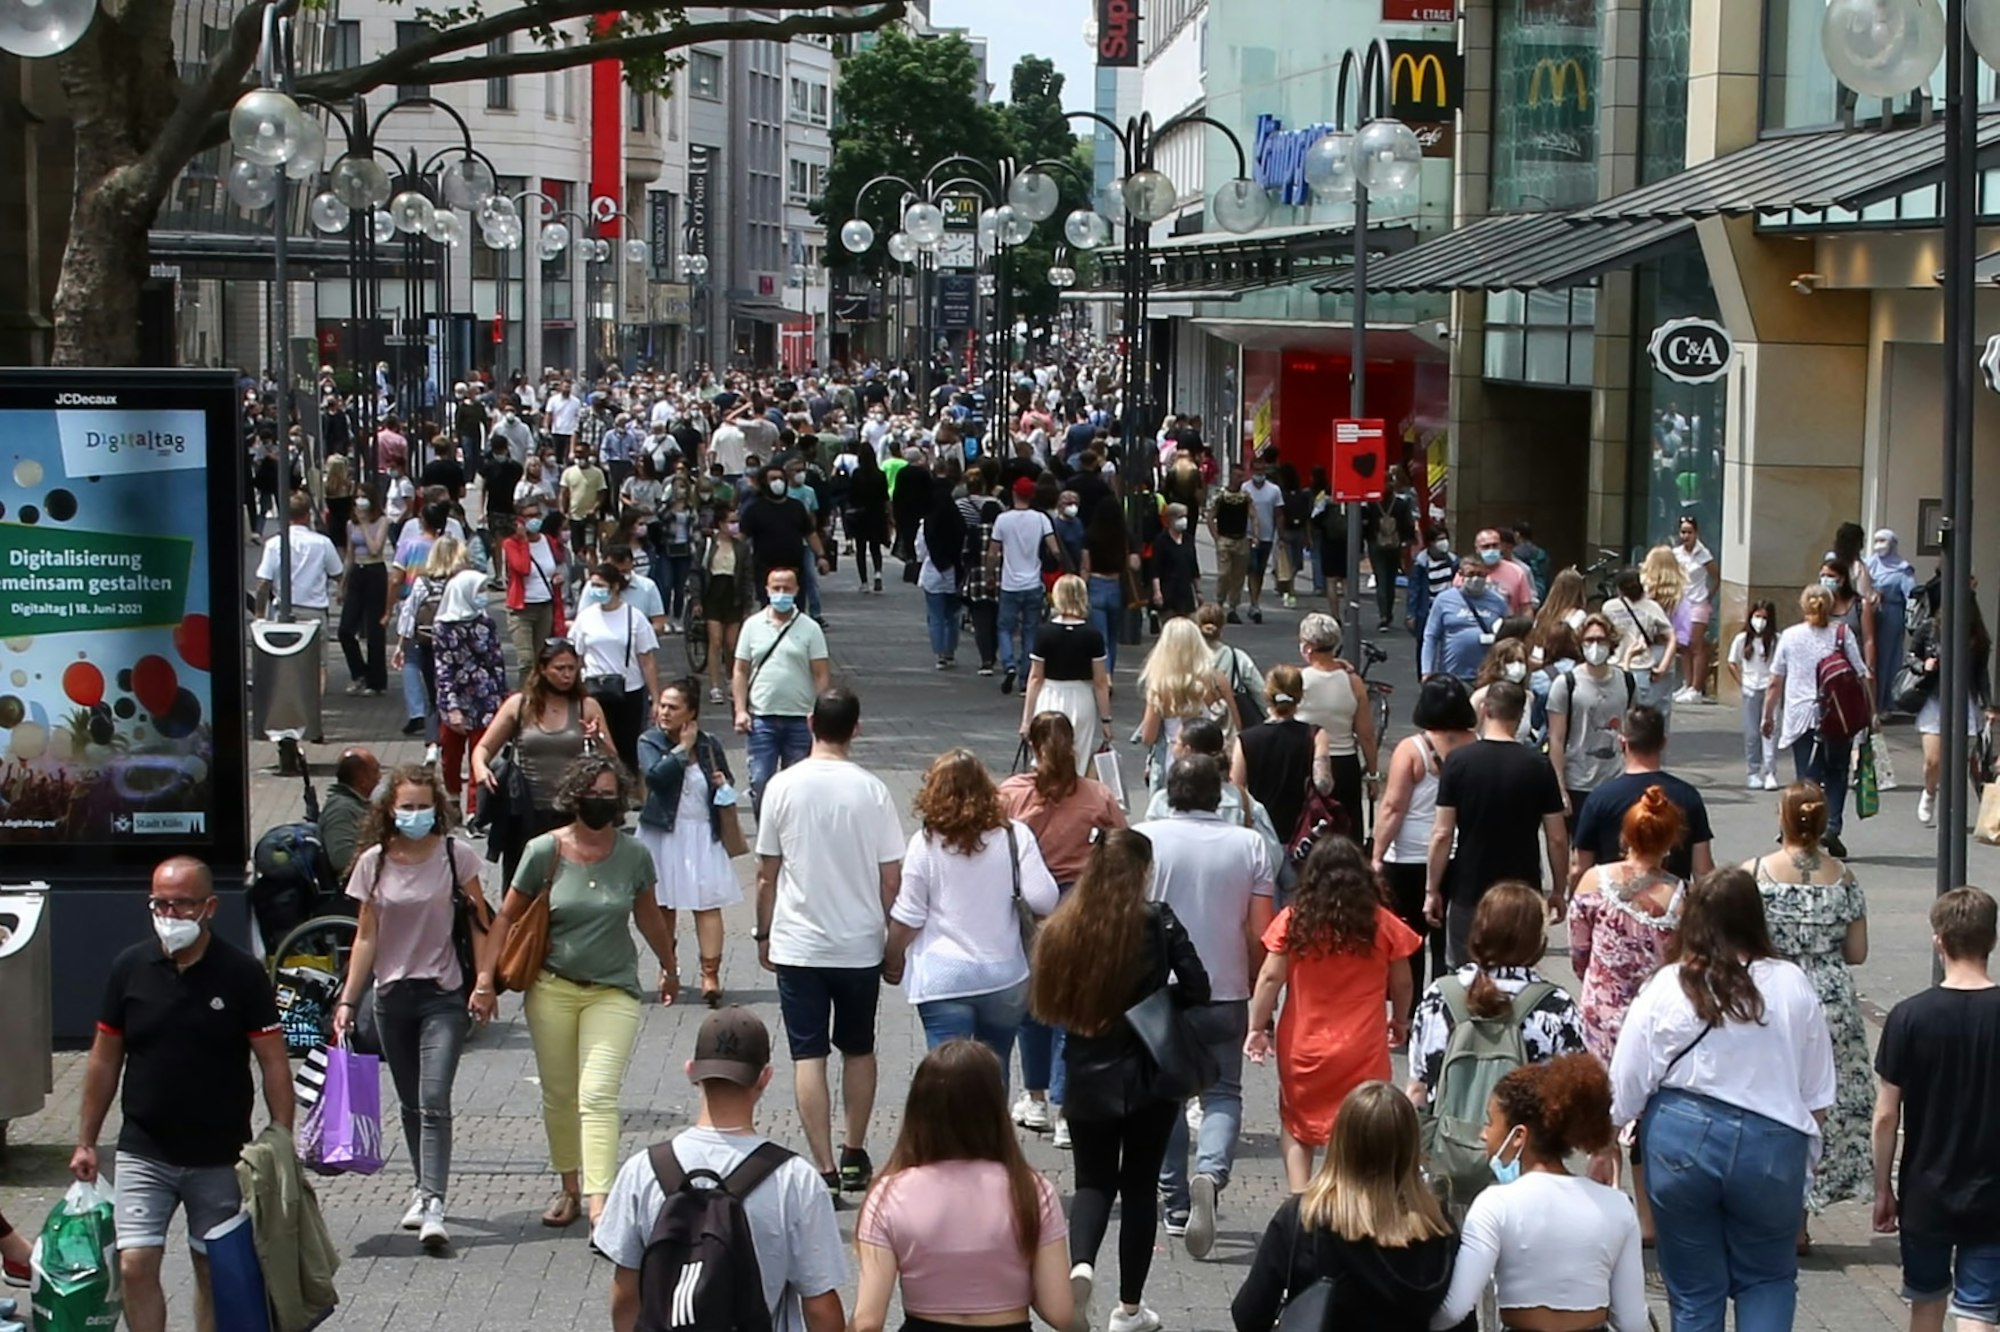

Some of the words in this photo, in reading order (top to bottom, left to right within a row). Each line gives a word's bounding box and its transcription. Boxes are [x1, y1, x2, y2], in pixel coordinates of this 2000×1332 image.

[1423, 9, 1451, 20] ETAGE
[1668, 336, 1722, 365] C&A
[55, 393, 117, 405] JCDecaux
[86, 430, 185, 453] Digitaltag
[9, 549, 142, 571] Digitalisierung
[0, 574, 84, 591] meinsam
[88, 574, 172, 595] gestalten
[11, 603, 67, 617] Digitaltag
[75, 603, 91, 615] 18.
[93, 603, 116, 615] Juni
[117, 603, 142, 614] 2021
[136, 817, 159, 828] Stadt
[162, 816, 183, 828] Köln
